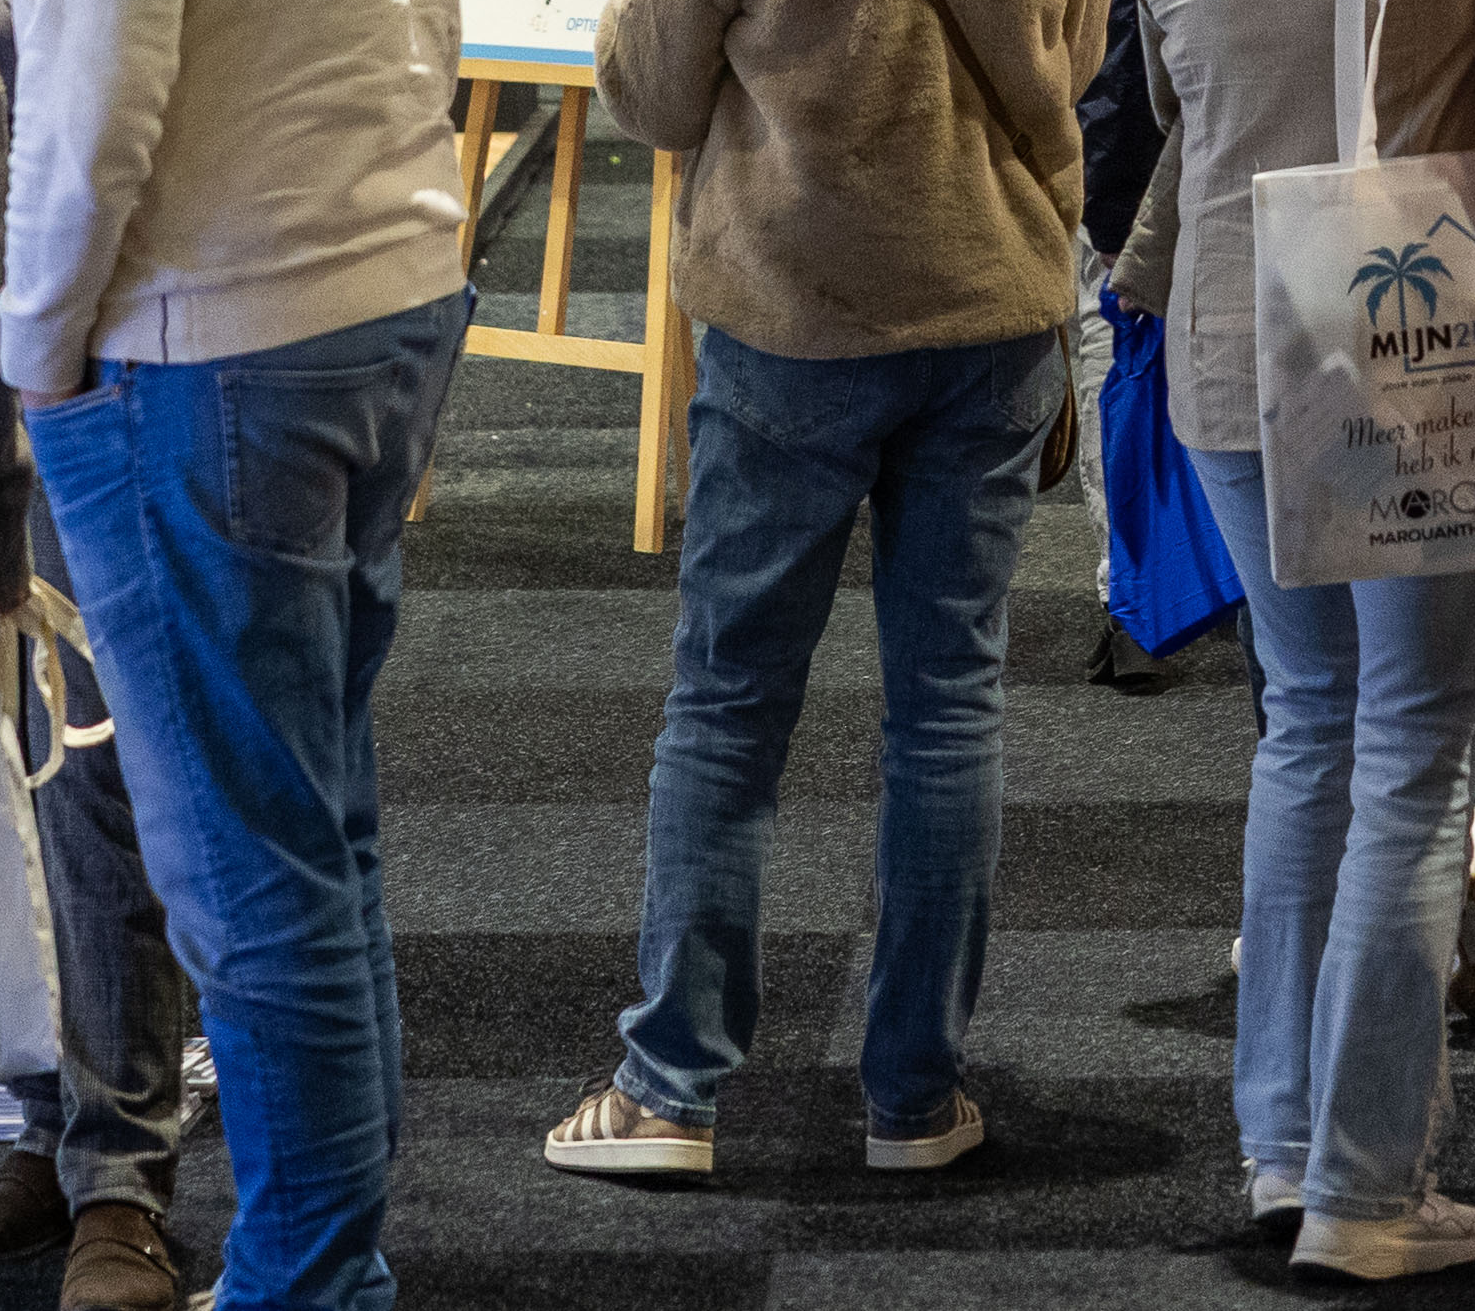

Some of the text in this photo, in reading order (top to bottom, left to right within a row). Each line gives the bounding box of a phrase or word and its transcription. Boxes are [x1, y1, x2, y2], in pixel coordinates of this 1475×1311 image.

[1340, 414, 1409, 451] Meer
[1393, 439, 1435, 478] heb
[1441, 431, 1462, 470] ik
